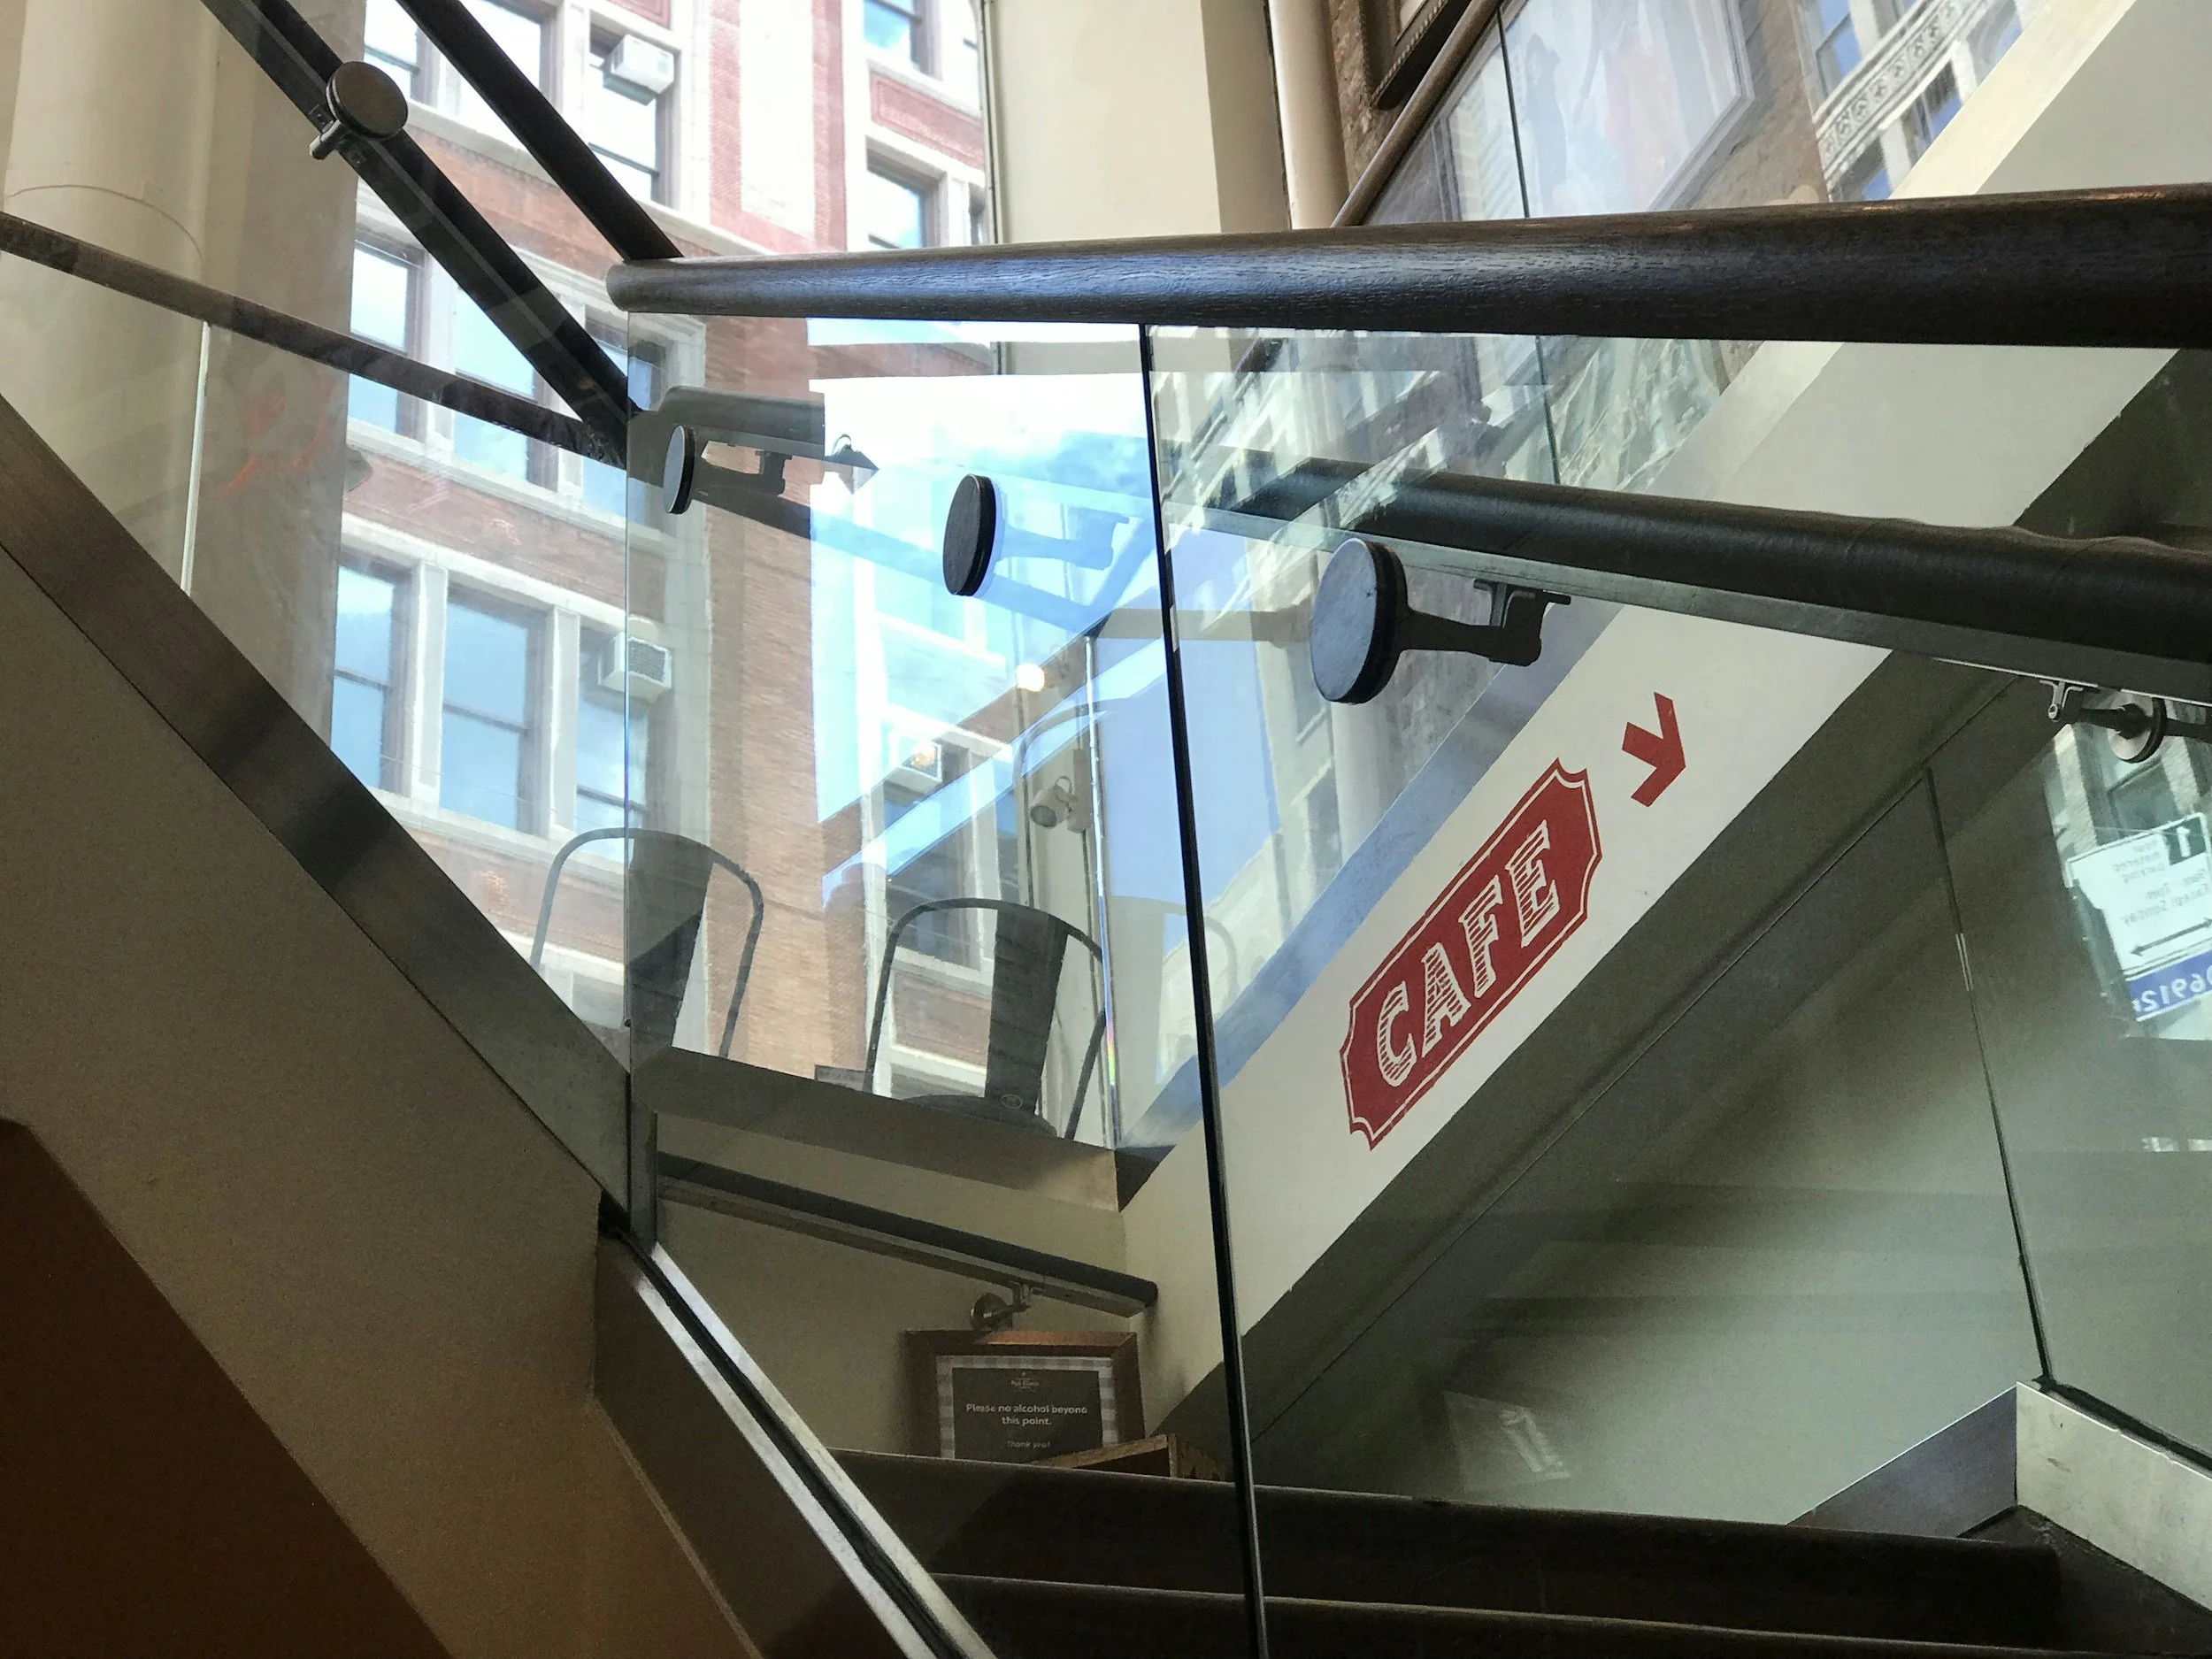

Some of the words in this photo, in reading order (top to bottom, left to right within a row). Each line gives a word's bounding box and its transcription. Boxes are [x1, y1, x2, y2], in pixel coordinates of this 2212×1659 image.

[1377, 819, 1560, 1087] CAFE
[965, 1403, 995, 1413] Please
[1013, 1403, 1050, 1413] alcohol
[1051, 1404, 1087, 1416] beyond
[1002, 1416, 1020, 1425] this
[1021, 1417, 1052, 1427] point.
[1007, 1440, 1031, 1448] Thank
